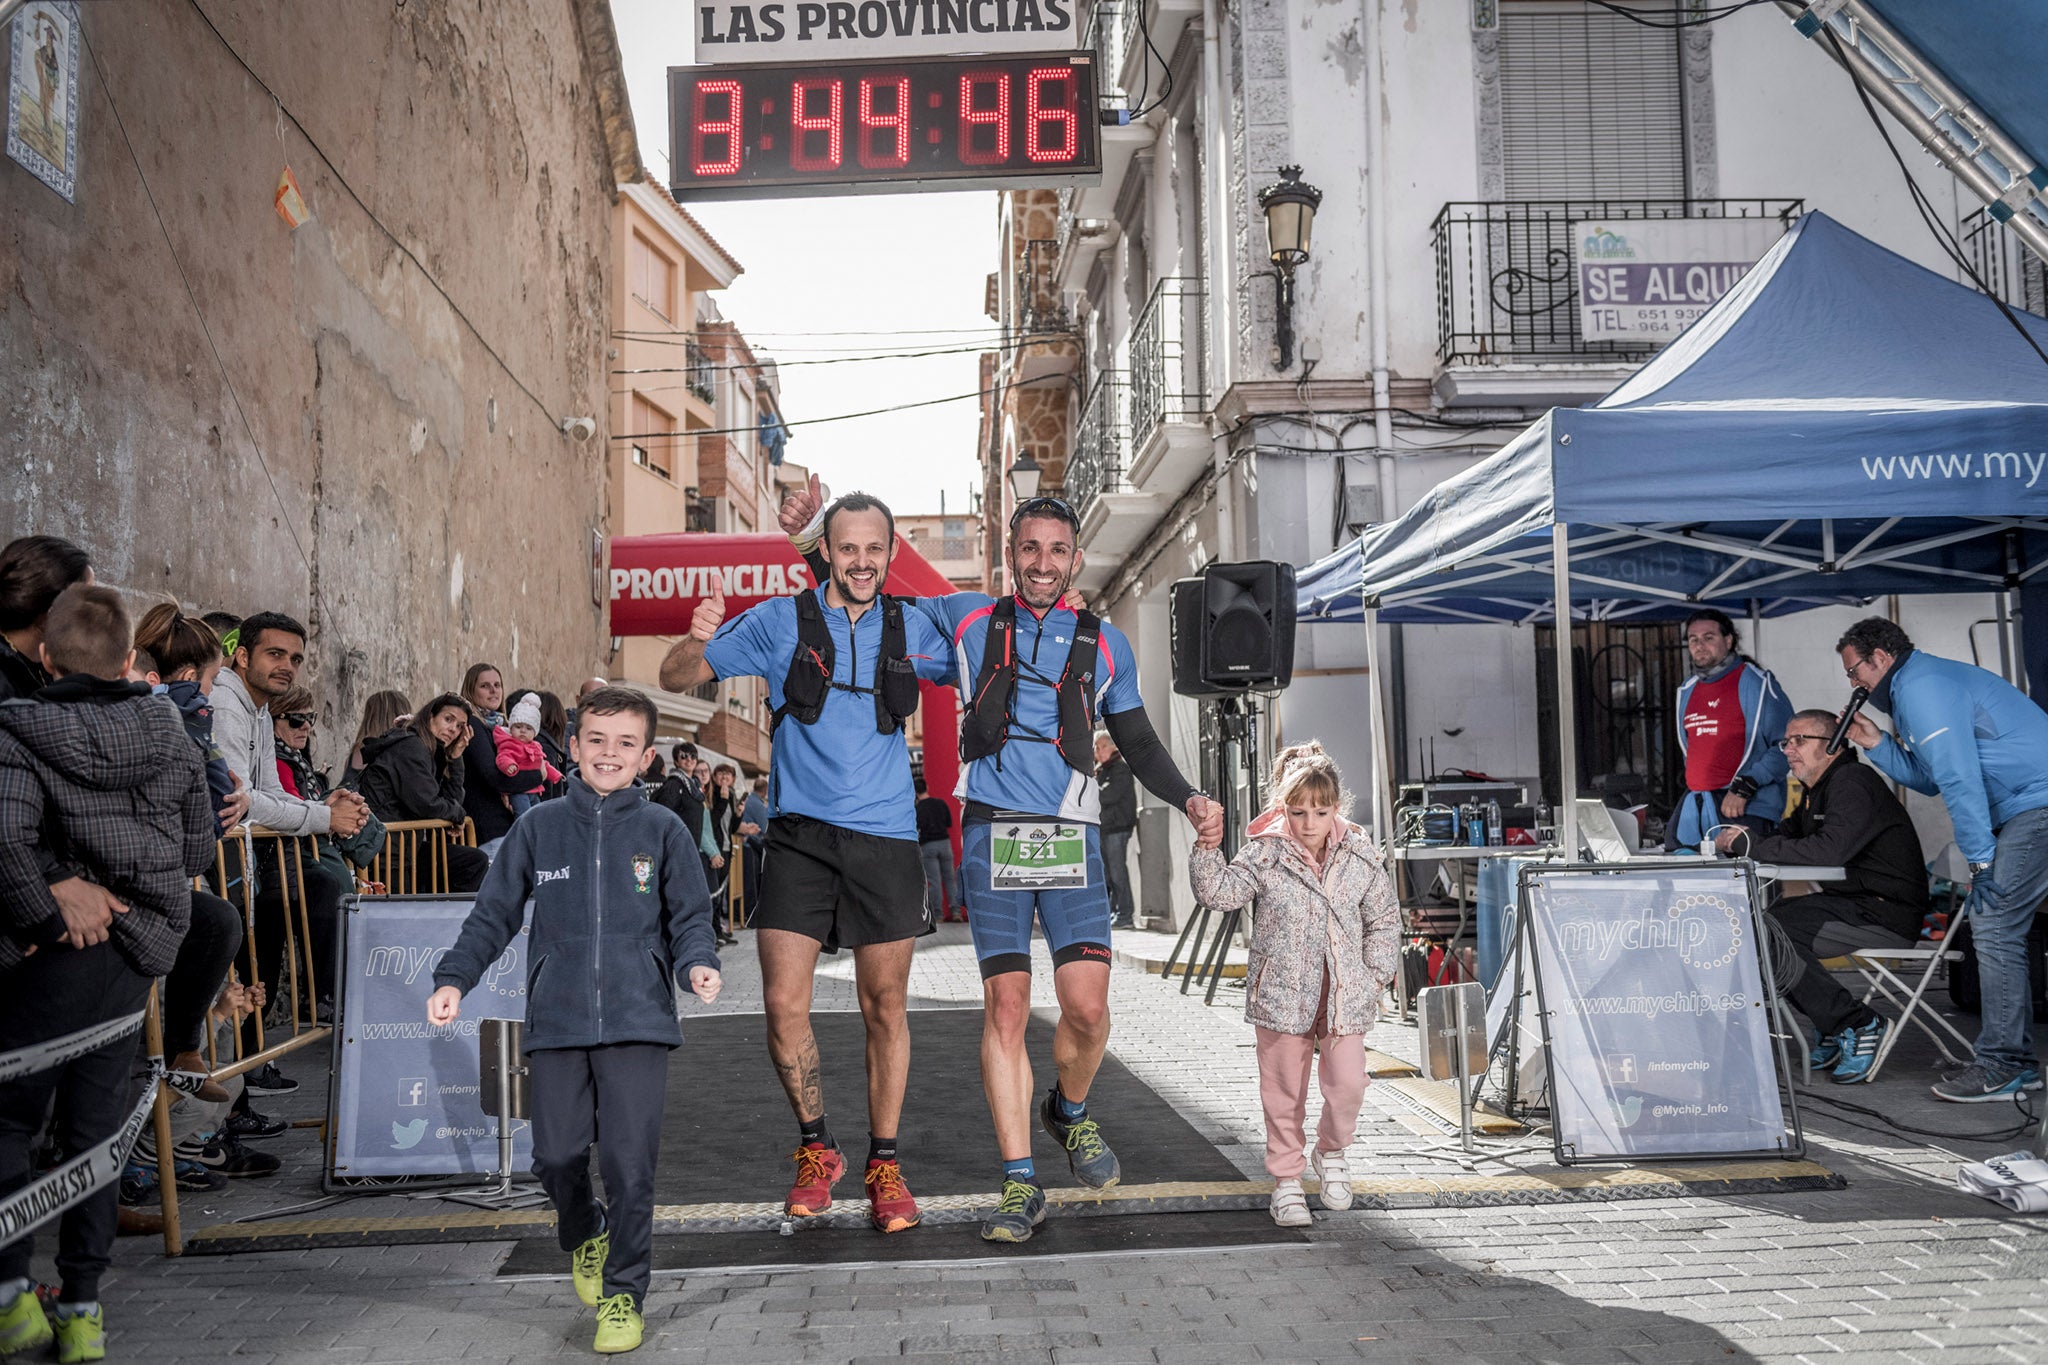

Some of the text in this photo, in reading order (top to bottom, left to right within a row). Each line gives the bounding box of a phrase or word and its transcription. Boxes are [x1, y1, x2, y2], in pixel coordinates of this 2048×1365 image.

[701, 0, 1071, 43] LAS PROVINCIAS
[1588, 267, 1629, 302] SE
[1638, 309, 1667, 319] 651
[1639, 322, 1670, 332] 964
[610, 564, 808, 599] PROVINCIAS
[1019, 843, 1057, 859] 521
[536, 866, 570, 886] FRAN
[1558, 908, 1707, 960] mychip
[365, 946, 517, 985] mycp
[1565, 991, 1747, 1018] www.mychip.es
[1647, 1060, 1710, 1073] /infomychip
[1652, 1103, 1729, 1117] @Mychip_Info
[69, 1158, 96, 1198] LAS
